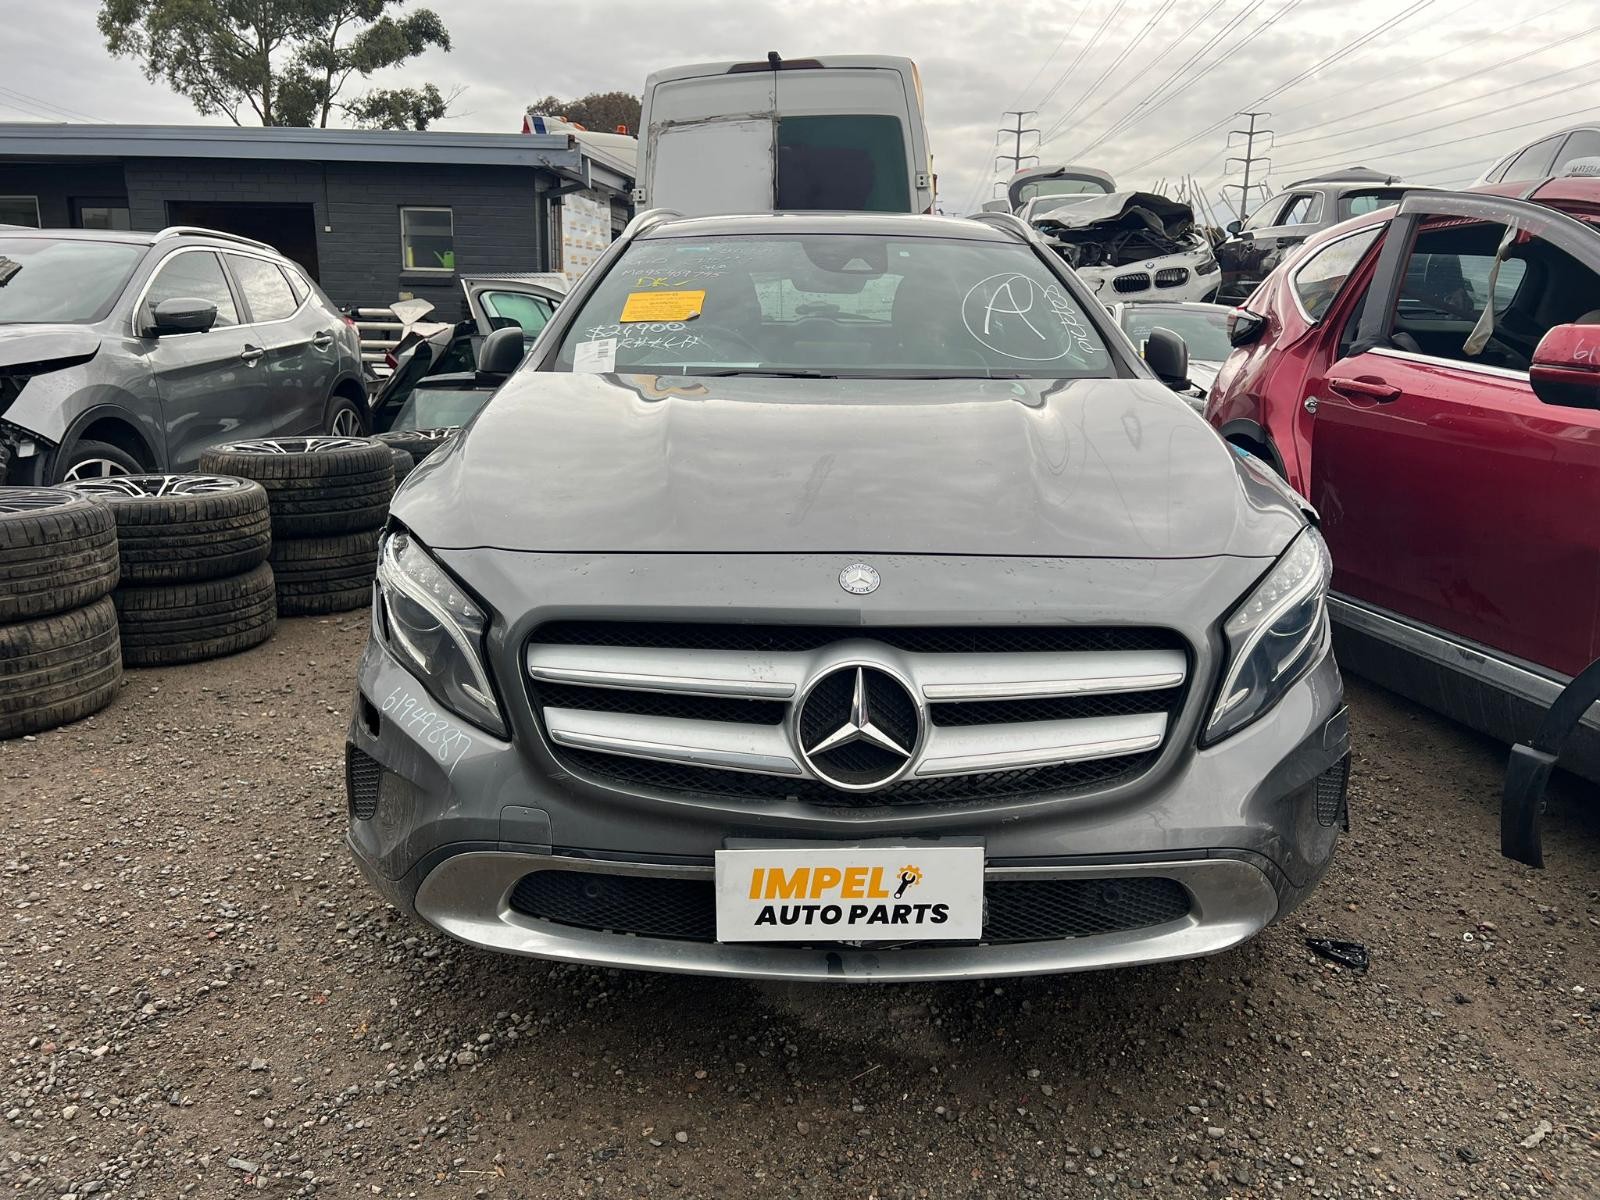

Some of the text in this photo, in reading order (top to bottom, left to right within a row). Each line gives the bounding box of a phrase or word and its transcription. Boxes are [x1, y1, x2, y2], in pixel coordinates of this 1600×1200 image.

[749, 866, 889, 900] IMPEL
[754, 903, 949, 926] AUTO PARTS
